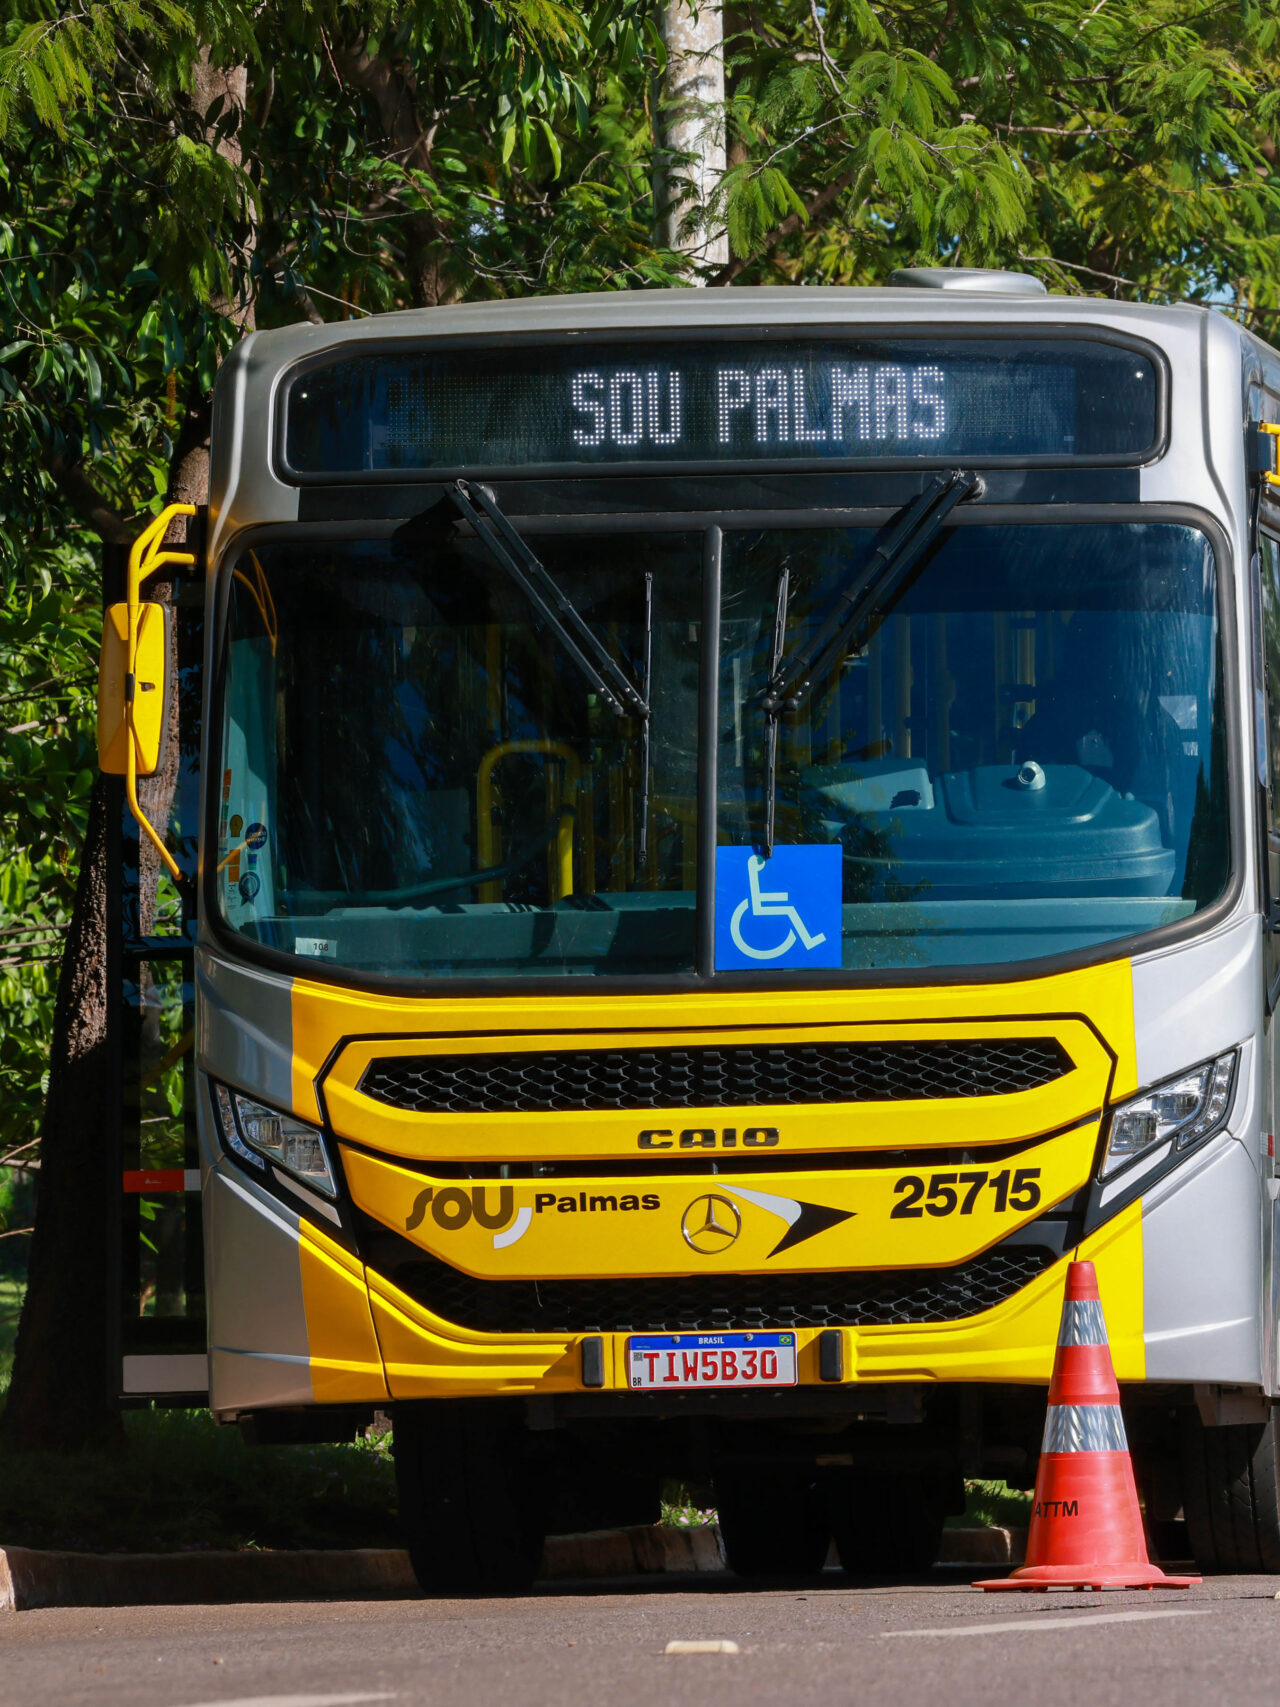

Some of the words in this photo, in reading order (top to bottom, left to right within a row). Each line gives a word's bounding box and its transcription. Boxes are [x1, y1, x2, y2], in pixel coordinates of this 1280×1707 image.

[572, 372, 681, 445] SOU
[718, 366, 945, 443] PALMAS
[637, 1127, 780, 1150] CAIO
[535, 1192, 660, 1214] Palmas
[890, 1168, 1042, 1220] 25715
[698, 1336, 725, 1345] BRASIL
[643, 1349, 778, 1383] TIW5B30
[632, 1376, 642, 1387] BR
[1034, 1500, 1079, 1518] ATTM
